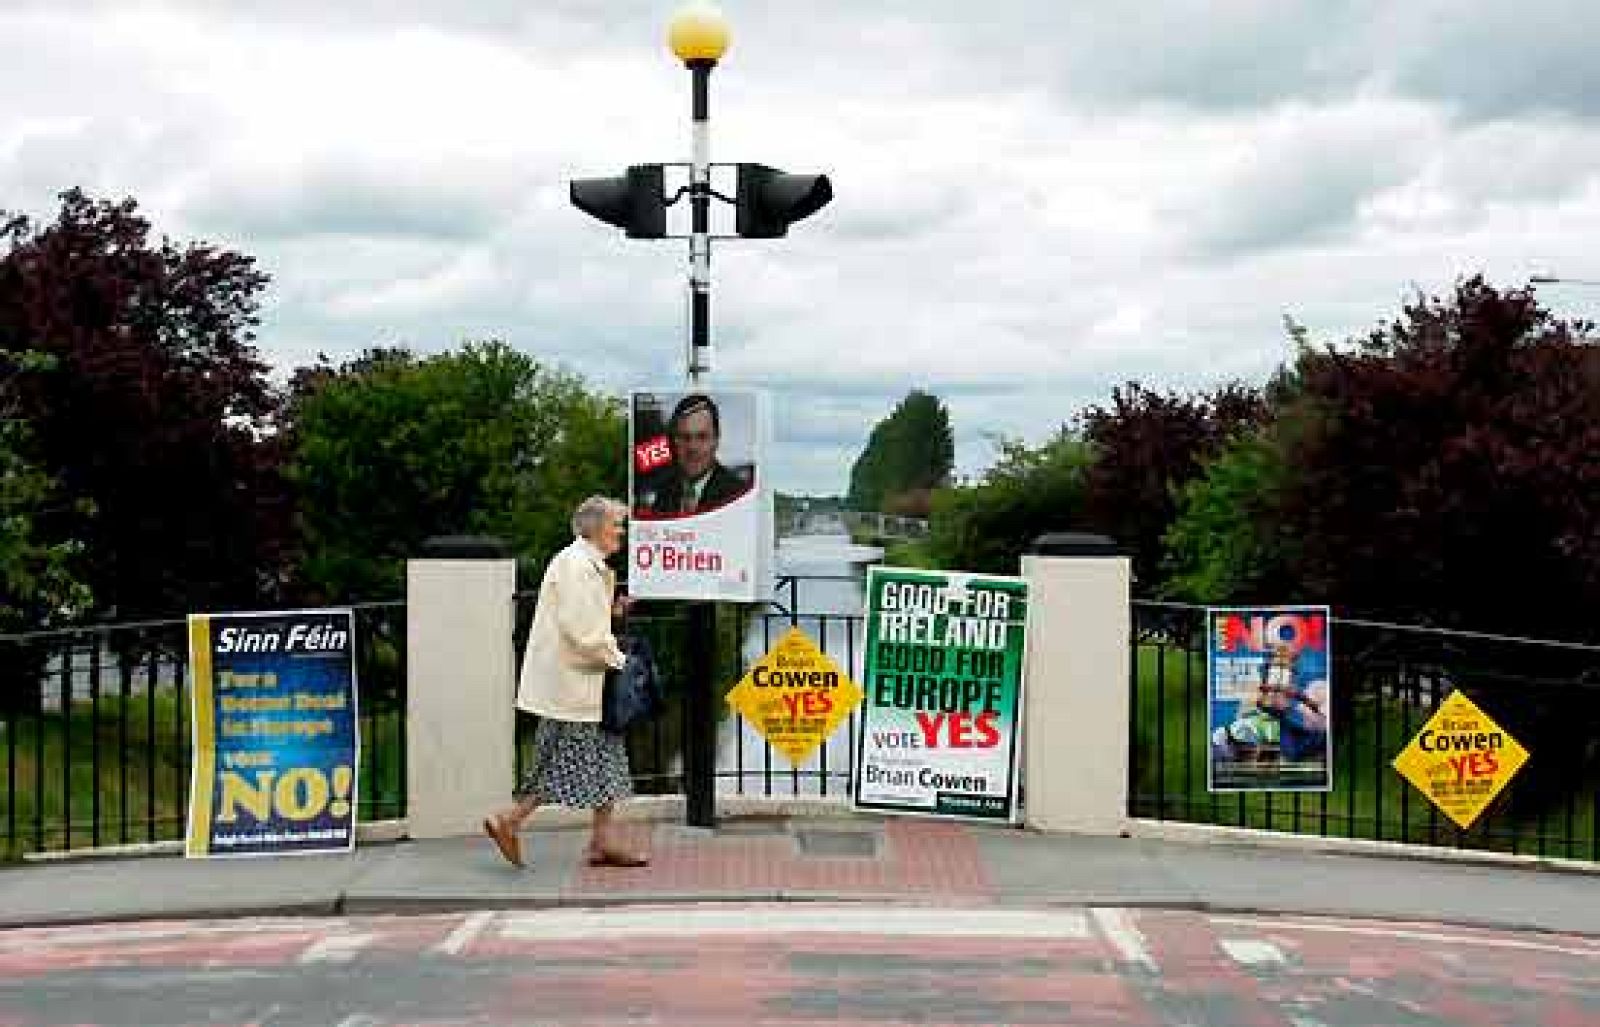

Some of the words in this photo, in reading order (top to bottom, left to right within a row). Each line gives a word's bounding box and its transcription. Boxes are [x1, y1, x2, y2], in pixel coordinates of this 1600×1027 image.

[636, 440, 670, 467] YES
[636, 543, 723, 571] O'Brien
[881, 582, 949, 615] GOOD
[964, 589, 1010, 618] FOR
[217, 627, 281, 652] Sinn
[284, 624, 347, 651] Féin
[879, 611, 1009, 650] IRELAND
[752, 665, 840, 688] Cowen
[877, 643, 947, 673] GOOD
[956, 649, 1005, 678] FOR
[782, 689, 833, 721] YES
[875, 674, 1002, 713] EUROPE
[872, 732, 921, 748] VOTE
[914, 709, 1002, 749] YES
[1419, 730, 1503, 751] Cowen
[866, 764, 915, 787] Brian
[918, 767, 988, 792] Cowen
[1448, 748, 1499, 781] YES
[217, 766, 352, 822] NO!
